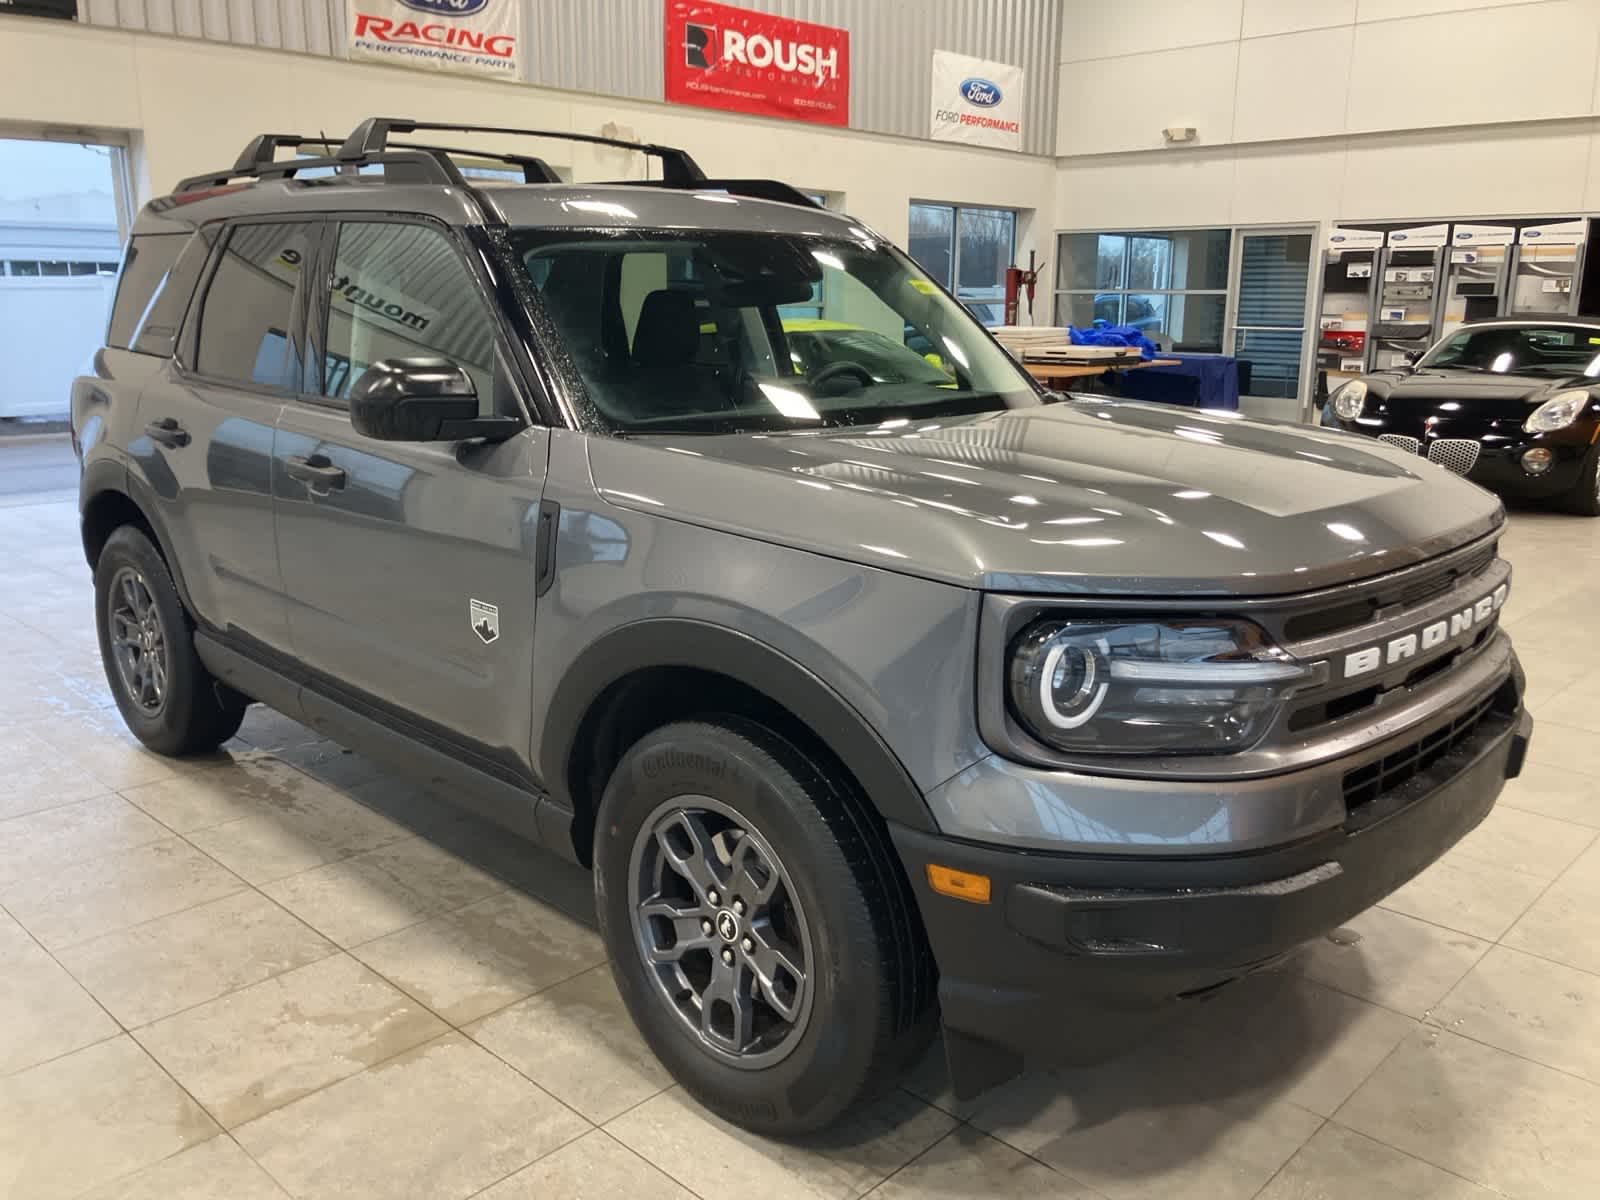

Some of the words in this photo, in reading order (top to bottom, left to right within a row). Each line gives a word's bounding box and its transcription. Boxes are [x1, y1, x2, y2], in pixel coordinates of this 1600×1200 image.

[354, 14, 515, 57] RACING
[355, 40, 471, 63] PERFORMANCE
[475, 57, 515, 69] PARTS
[723, 29, 838, 80] ROUSH
[967, 81, 994, 104] Ford
[936, 109, 959, 123] FORD
[960, 113, 1020, 133] PERFORMANCE
[1344, 584, 1507, 678] BRONCO
